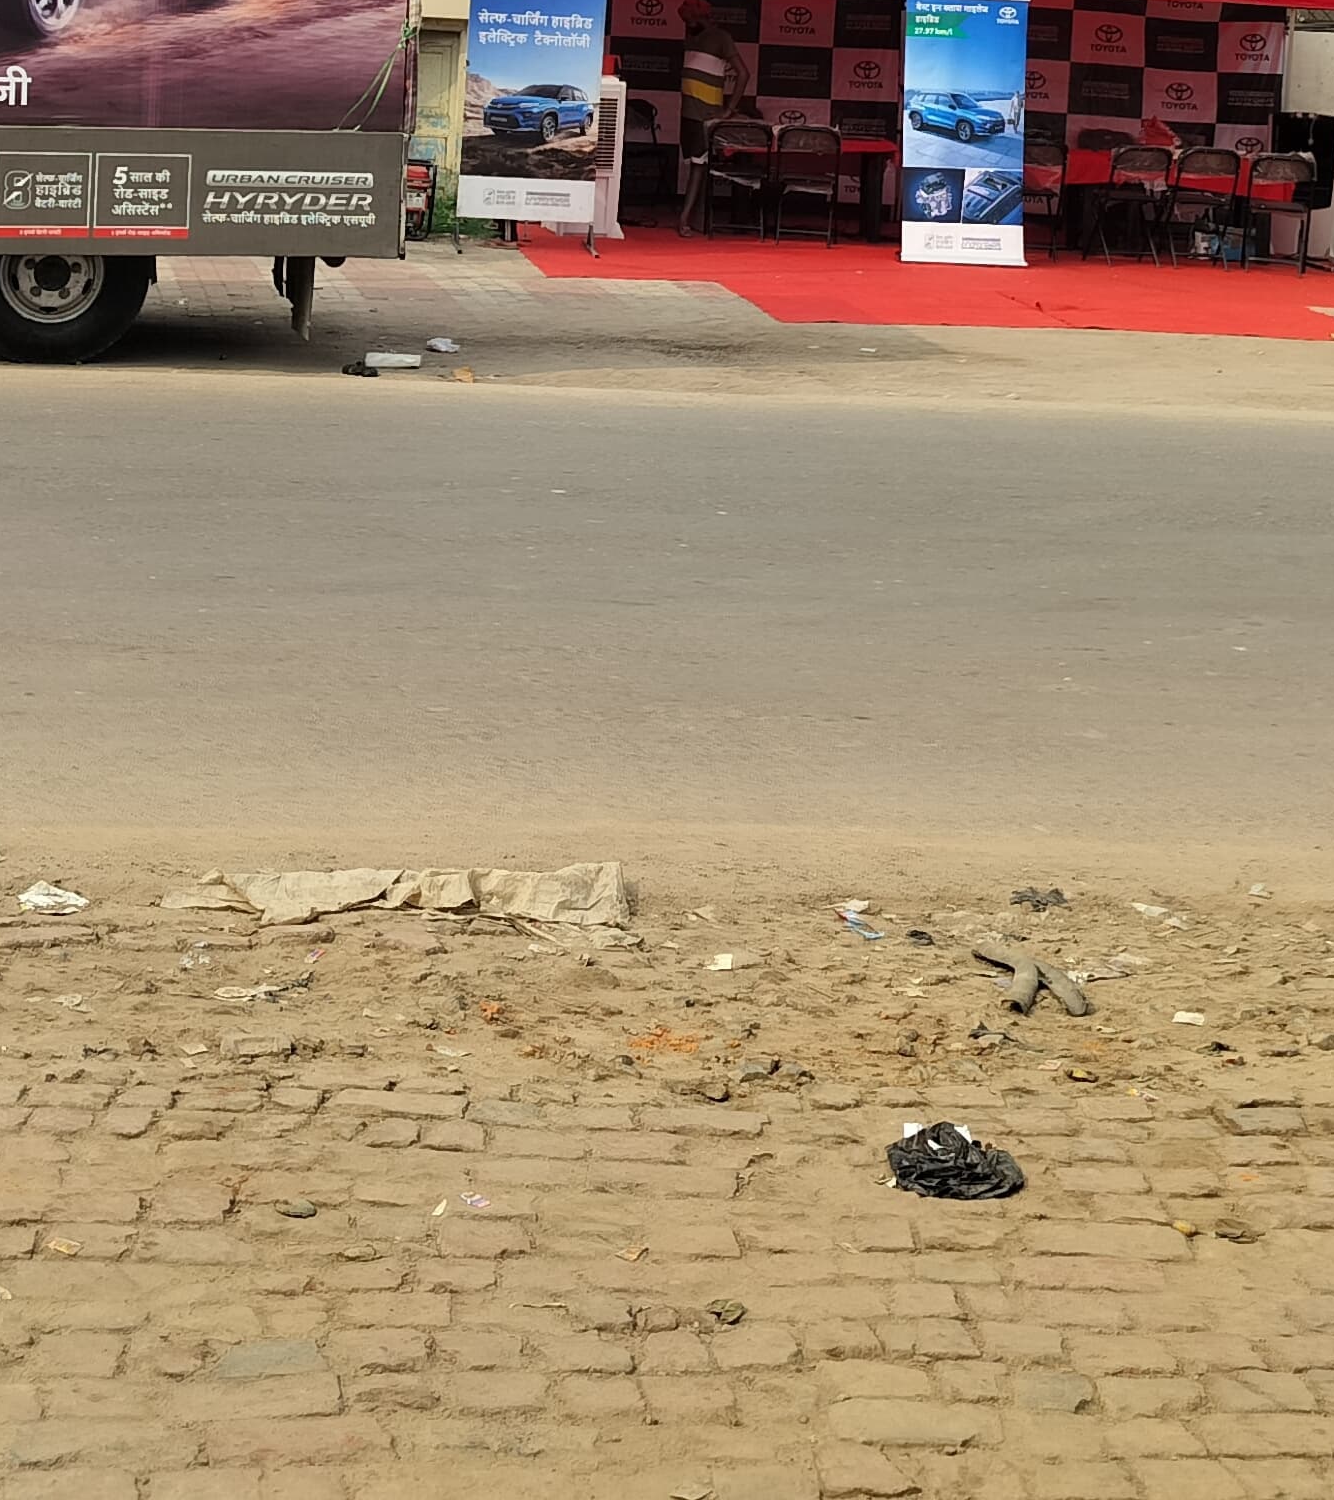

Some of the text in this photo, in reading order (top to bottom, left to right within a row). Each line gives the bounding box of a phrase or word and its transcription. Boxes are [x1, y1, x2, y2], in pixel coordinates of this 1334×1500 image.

[1167, 0, 1204, 9] TOYOTA
[478, 9, 593, 30] सेल्फ-चार्जिंग हाइब्रिड
[630, 17, 667, 26] TOYOTA
[779, 25, 816, 35] TOYOTA
[478, 28, 528, 46] इलेक्ट्रिक
[1091, 44, 1127, 53] TOYOTA
[1235, 53, 1270, 62] TOYOTA
[848, 80, 884, 90] TOYOTA
[1161, 101, 1198, 111] TOYOTA
[113, 167, 128, 184] 5
[155, 169, 171, 183] की
[212, 174, 368, 186] URBAN CRUISER
[36, 182, 82, 197] हाइब्रिड
[113, 185, 169, 199] रोड-साइड
[204, 192, 373, 211] HYRYDER
